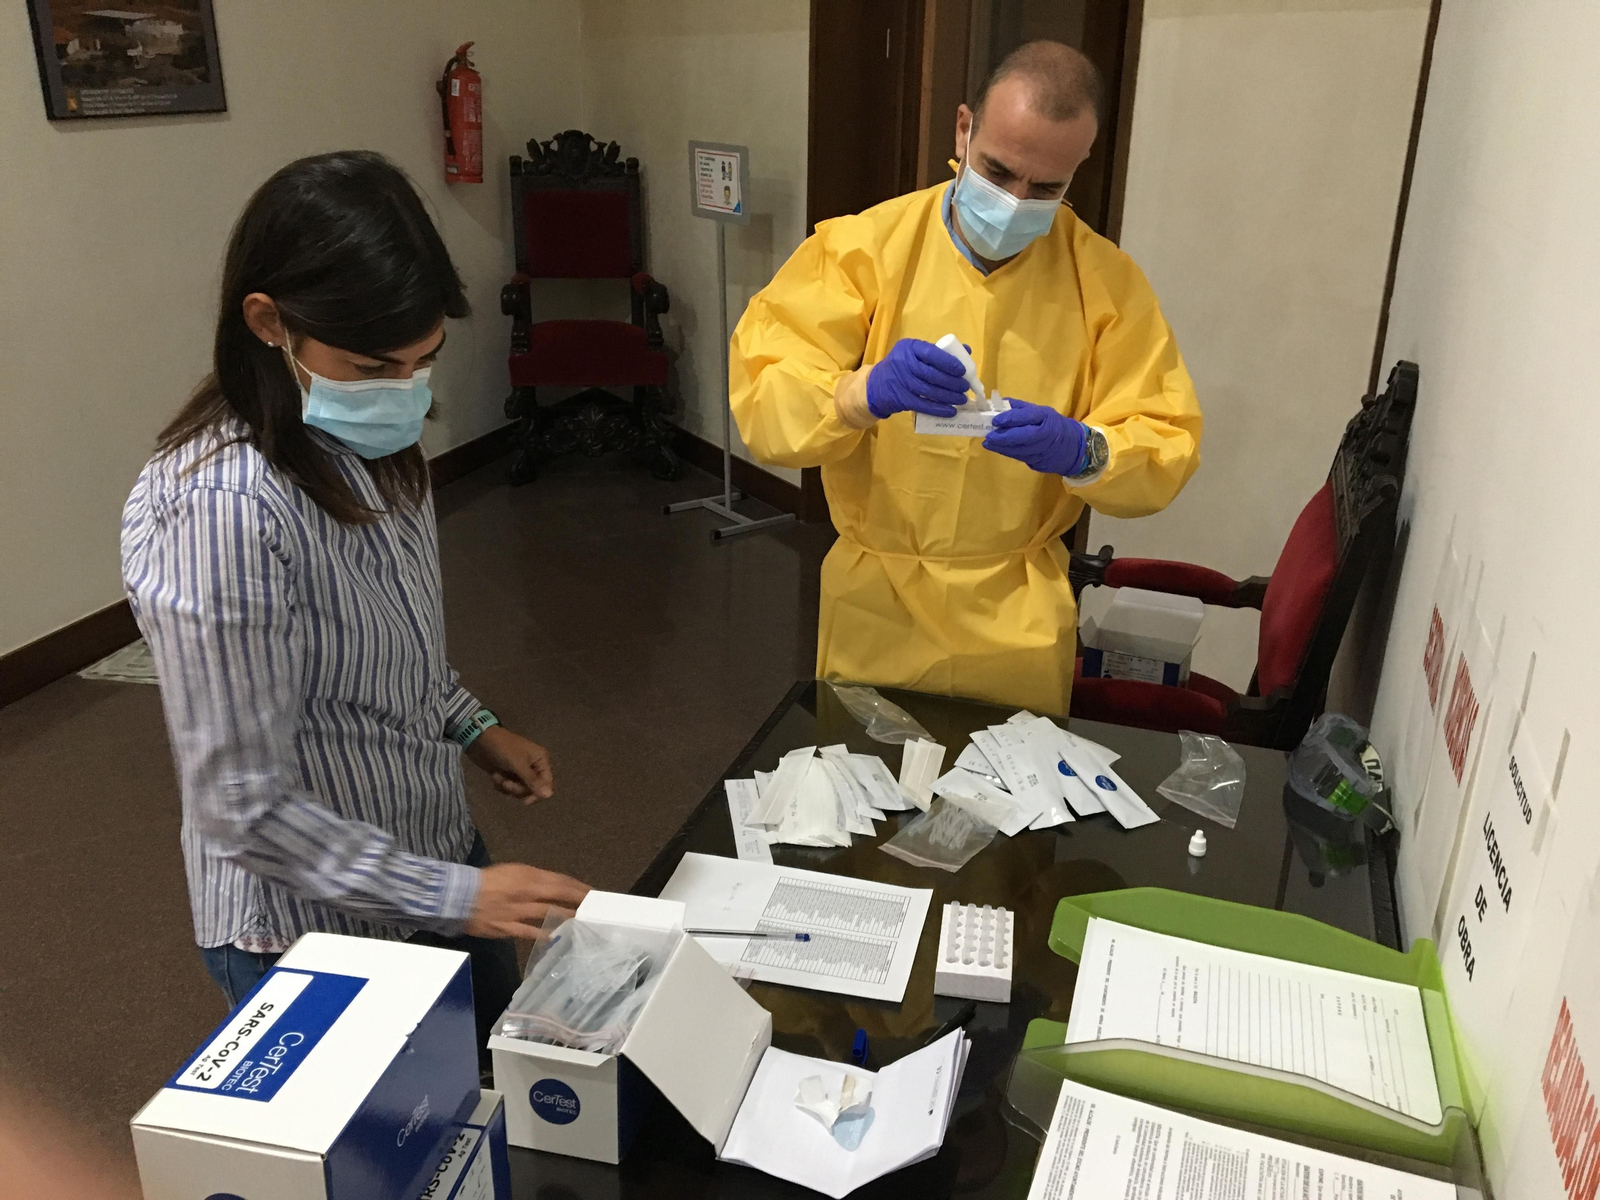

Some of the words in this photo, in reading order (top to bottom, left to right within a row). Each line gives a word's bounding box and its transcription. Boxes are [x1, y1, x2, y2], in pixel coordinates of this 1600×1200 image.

[1508, 755, 1532, 825] SOLICITUD
[1483, 812, 1513, 914] LICENCIA
[1475, 884, 1487, 923] DE
[1457, 915, 1476, 982] OBRA
[196, 1002, 274, 1081] SARS-CoV-2
[236, 1032, 304, 1093] CerTest
[222, 1060, 253, 1091] BIOTEC
[533, 1090, 577, 1109] CerTest
[556, 1107, 577, 1115] BIOTEC
